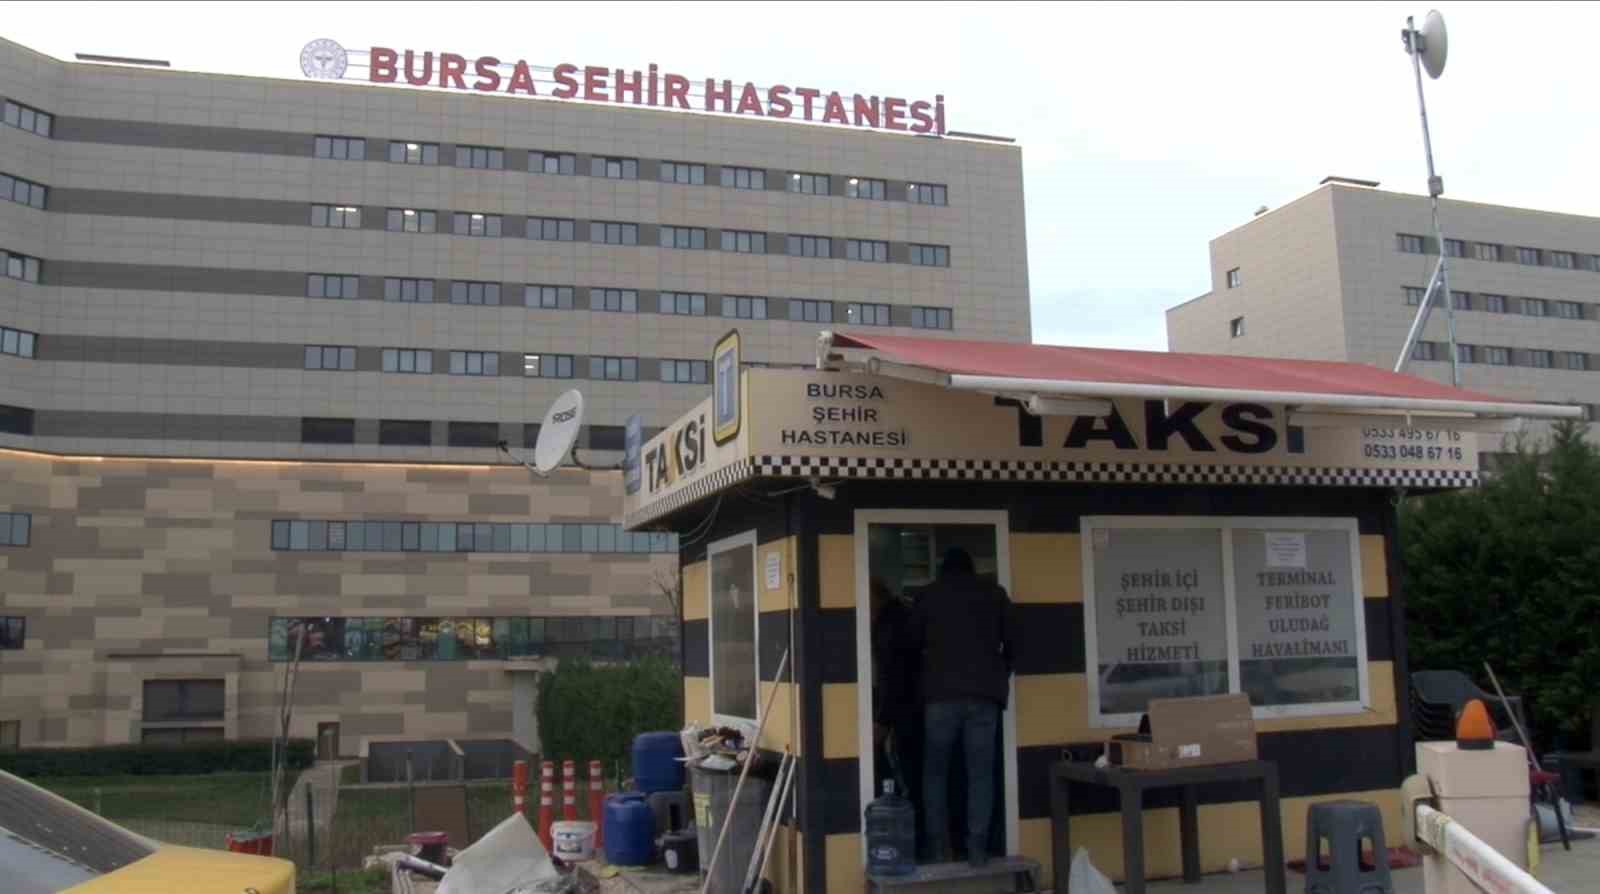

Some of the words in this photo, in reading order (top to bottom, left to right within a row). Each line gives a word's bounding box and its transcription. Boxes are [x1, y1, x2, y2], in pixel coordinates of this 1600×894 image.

[369, 46, 537, 95] BURSA
[704, 78, 946, 136] HASTANESİ
[807, 383, 884, 399] BURSA
[813, 404, 877, 424] ŞEHİR
[781, 427, 906, 446] HASTANESİ
[1364, 444, 1396, 459] 0533
[1400, 445, 1424, 460] 048
[1427, 446, 1442, 460] 67
[1447, 446, 1463, 461] 16
[1120, 568, 1171, 592] ŞEHİR
[1115, 593, 1168, 617] ŞEHİR
[1264, 592, 1331, 610] FERİBOT
[1136, 618, 1186, 637] TAKSİ
[1268, 613, 1330, 633] ULUDAĞ
[1126, 641, 1200, 662] HİZMETİ
